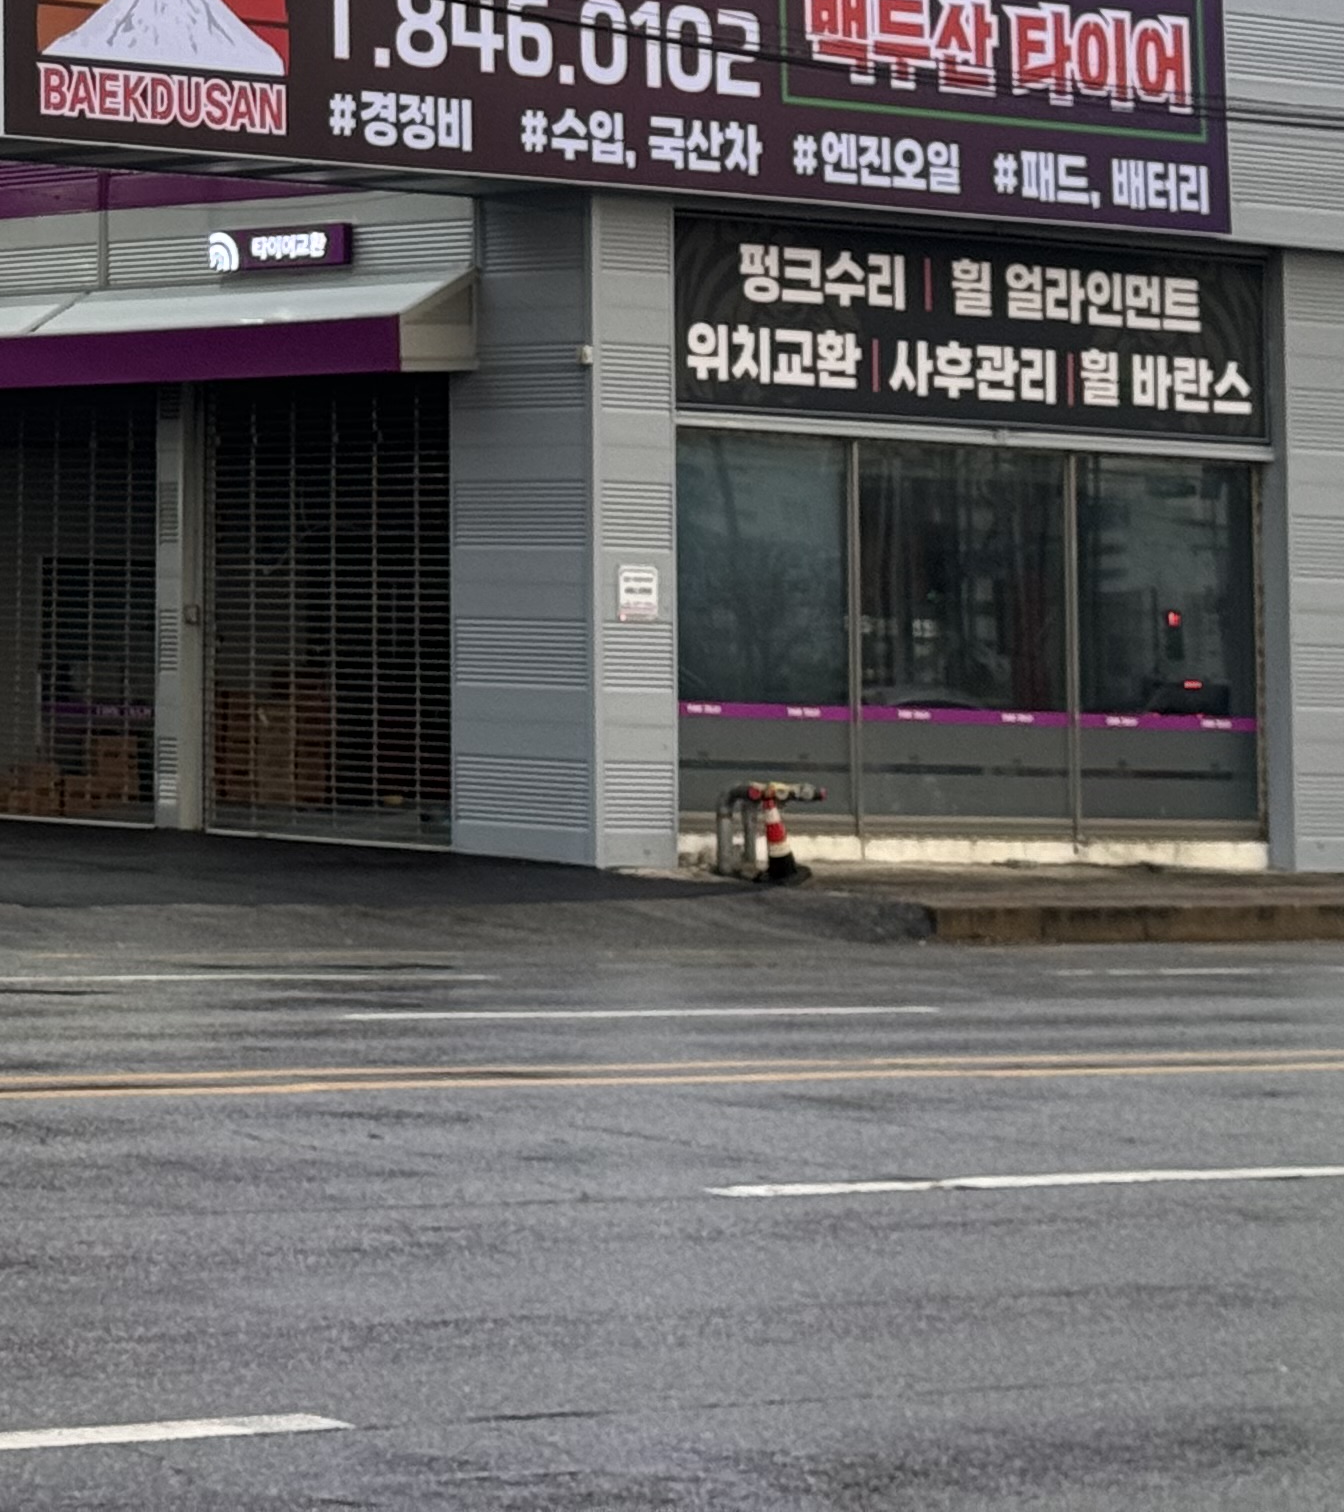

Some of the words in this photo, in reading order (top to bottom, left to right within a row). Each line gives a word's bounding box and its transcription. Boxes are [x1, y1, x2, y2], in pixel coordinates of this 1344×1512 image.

[36, 62, 288, 136] BAEKDUSAN
[1001, 0, 1195, 115] 타이어
[329, 90, 474, 153] #경정비
[520, 108, 637, 170] #수입,
[648, 115, 763, 177] 국산차
[792, 131, 962, 196] #엔진오일
[993, 148, 1102, 211] #패드,
[1111, 156, 1211, 216] 배터리
[251, 231, 328, 261] 타이어교환
[738, 242, 907, 313] 펑크수리
[951, 258, 993, 318] 휠
[1004, 264, 1203, 333] 얼라인먼트
[685, 321, 863, 390] 위치교환
[888, 339, 1058, 406] 사후관리
[1079, 348, 1120, 407] 휠
[1131, 353, 1253, 415] 바란스
